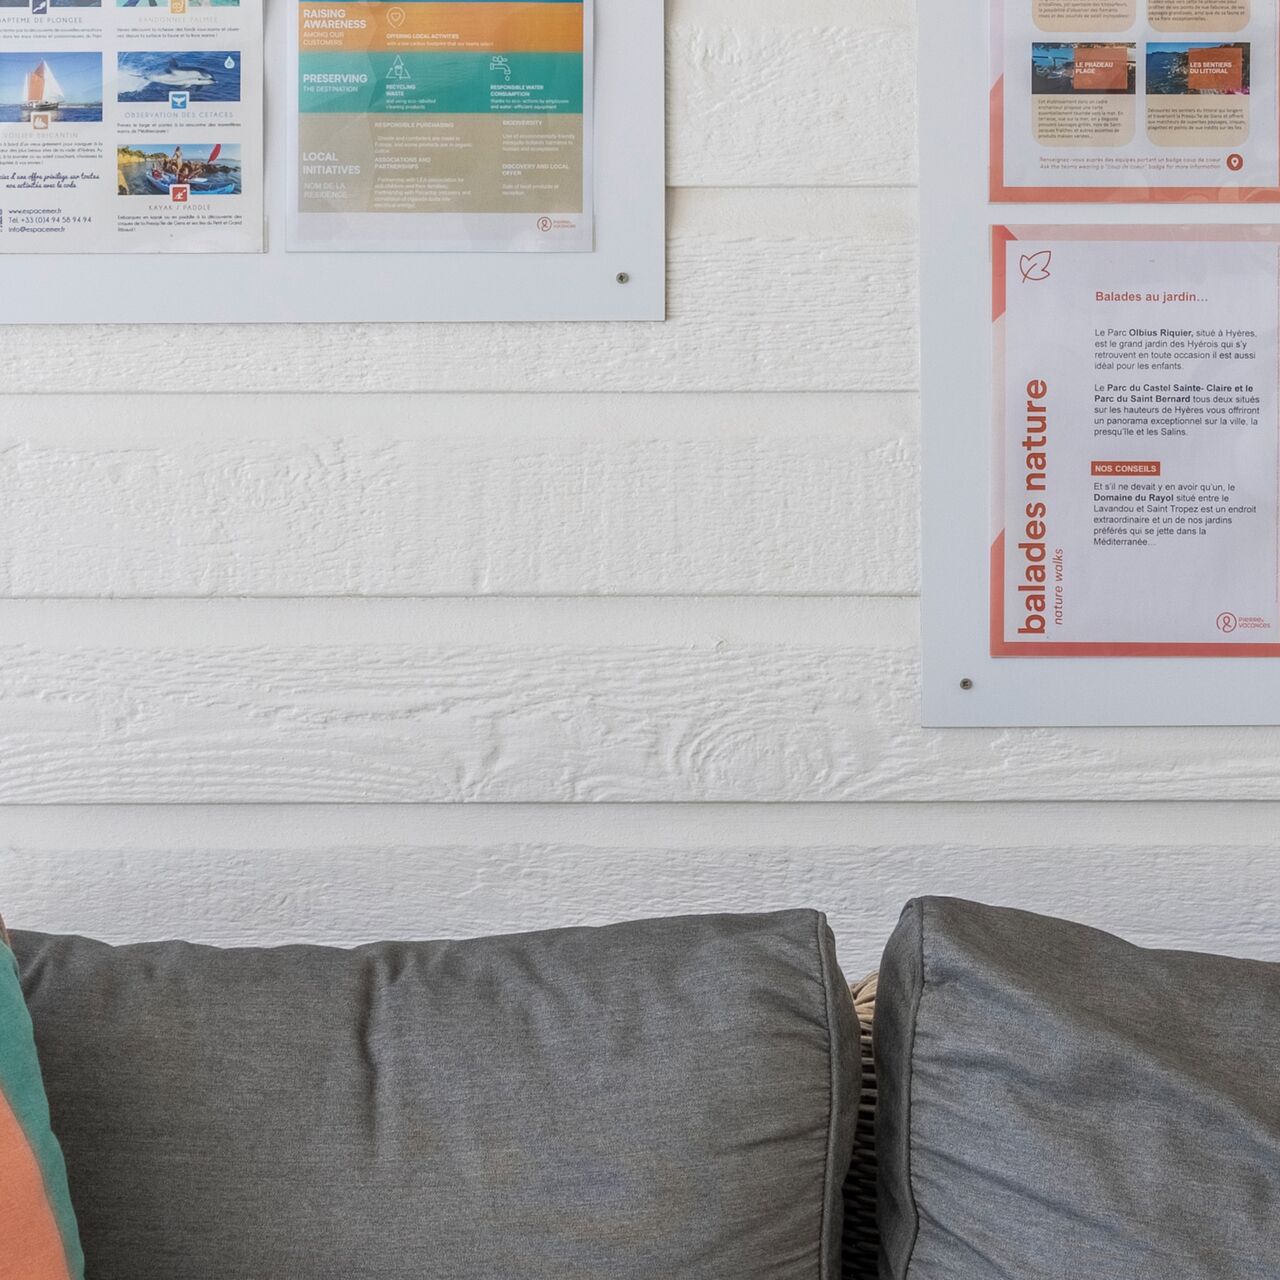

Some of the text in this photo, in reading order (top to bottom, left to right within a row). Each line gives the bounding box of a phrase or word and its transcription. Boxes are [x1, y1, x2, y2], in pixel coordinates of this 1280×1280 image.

[303, 9, 346, 19] RAISING
[303, 20, 367, 29] AWARENESS
[303, 73, 368, 84] PRESERVING
[303, 152, 338, 162] LOCAL
[303, 165, 361, 175] INITIATIVES
[1096, 292, 1141, 301] Balades
[1163, 292, 1207, 303] jardin...
[1095, 465, 1157, 473] NOS CONSEILS
[1018, 379, 1047, 634] balades nature
[1052, 548, 1063, 625] nature walks
